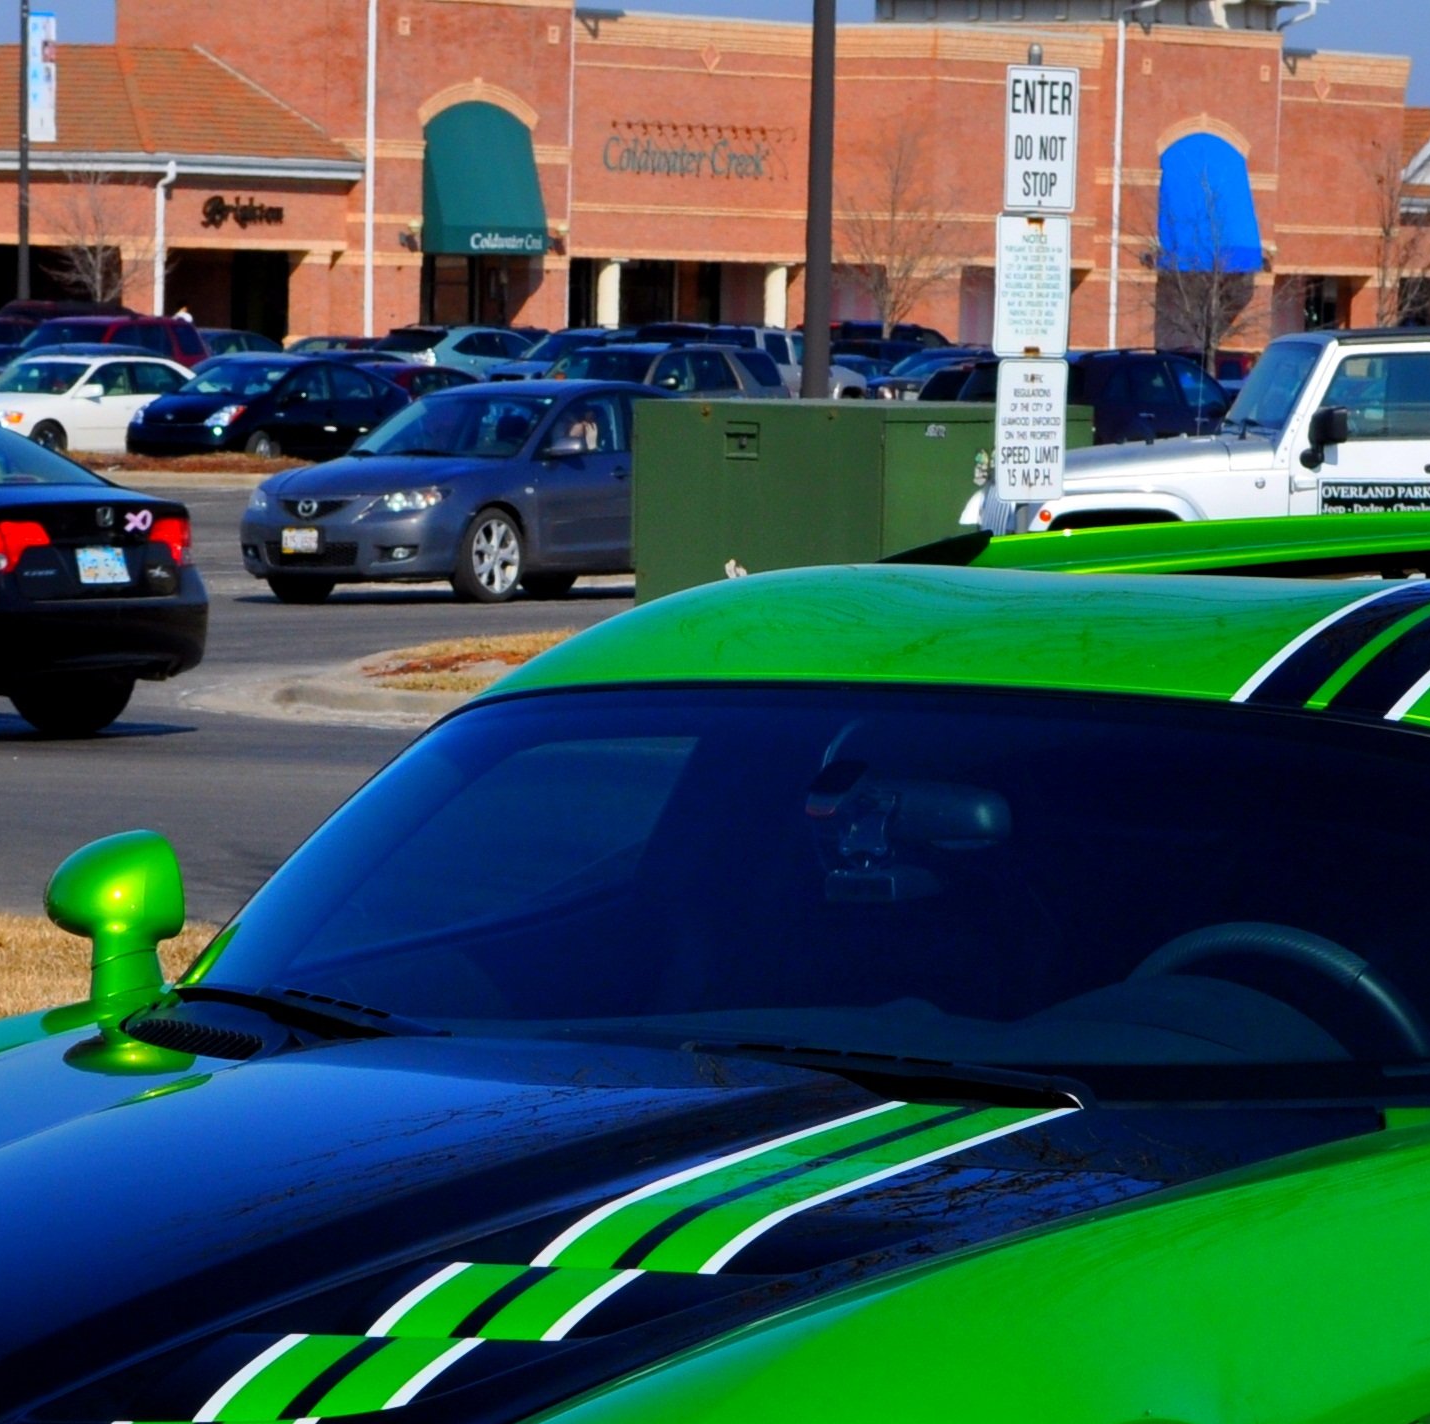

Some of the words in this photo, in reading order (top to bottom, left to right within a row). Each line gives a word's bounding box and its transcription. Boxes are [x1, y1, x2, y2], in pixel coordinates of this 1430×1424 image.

[1011, 79, 1073, 116] ENTER
[603, 136, 705, 174] Coldwater
[710, 138, 765, 177] Creek
[1014, 134, 1033, 160] DO
[1039, 136, 1067, 162] NOT
[1022, 171, 1058, 197] STOP
[470, 232, 524, 250] Coldwater
[1013, 388, 1051, 398] REGULATIONS
[1011, 403, 1018, 412] OF
[1020, 403, 1029, 412] THE
[1031, 403, 1044, 412] CITY
[1046, 403, 1053, 412] OF
[1004, 431, 1014, 440] ON
[1016, 431, 1027, 440] THIS
[1030, 431, 1057, 440] PROPERTY
[1001, 446, 1030, 464] SPEED
[1034, 446, 1059, 464] LIMIT
[1007, 468, 1017, 487] 15
[1322, 486, 1395, 499] OVERLAND
